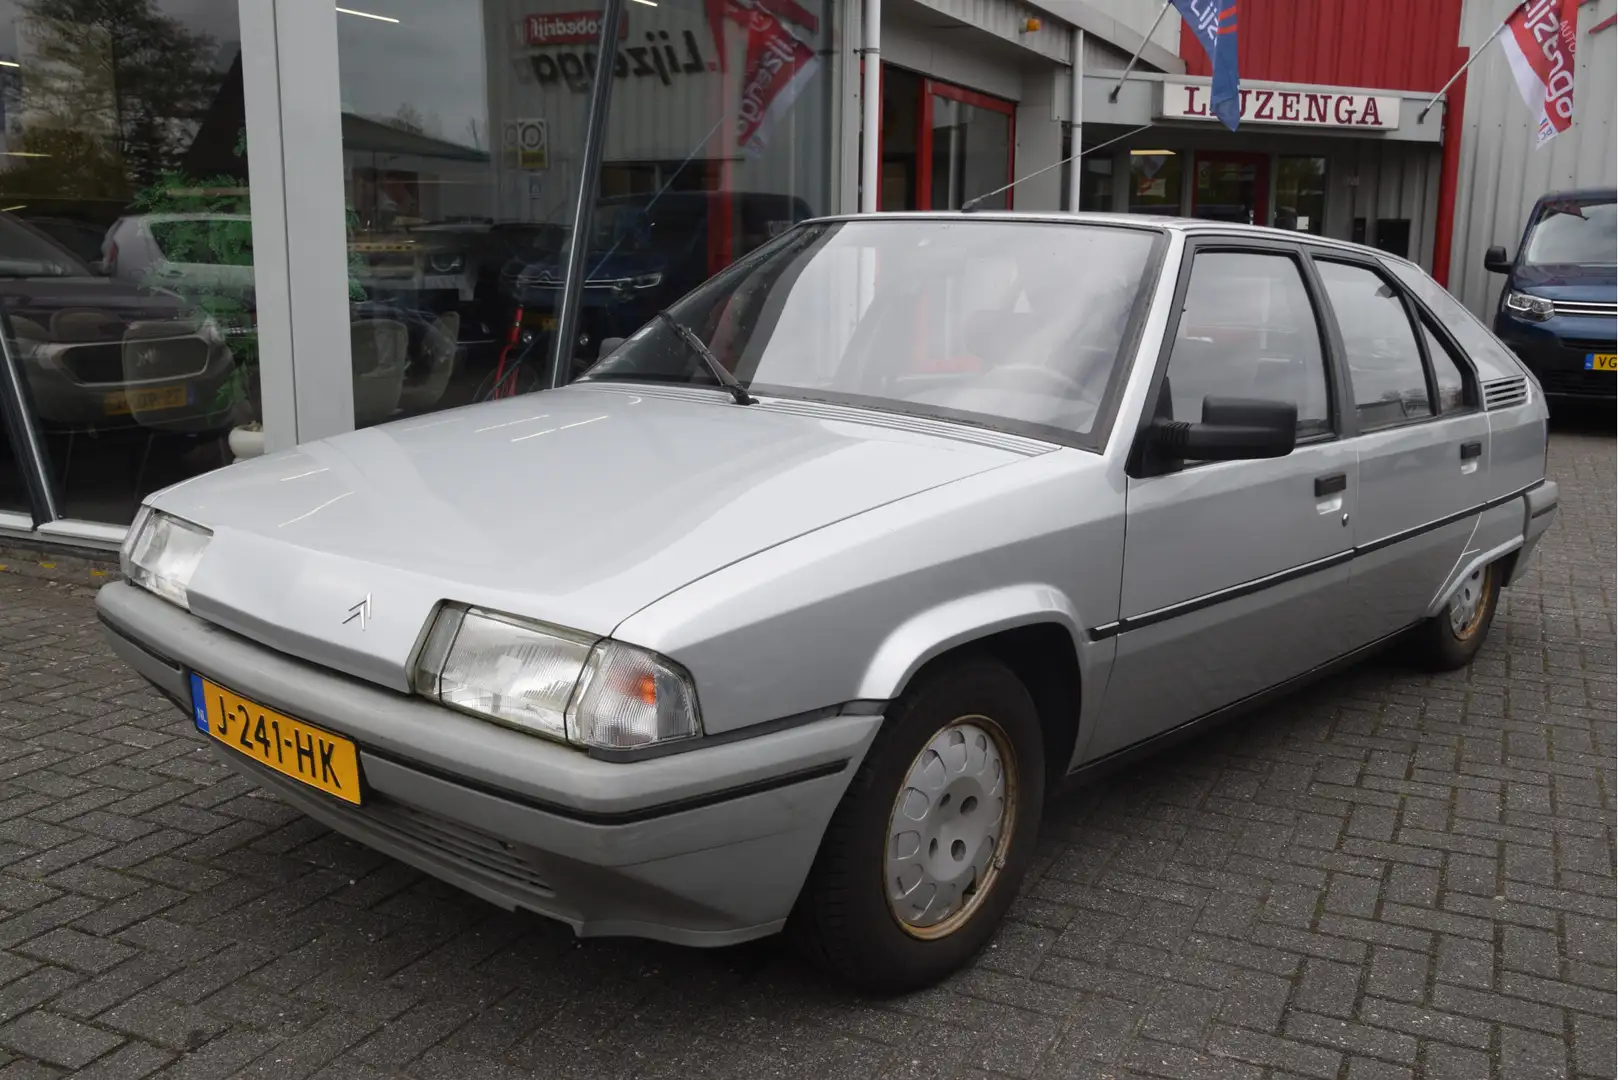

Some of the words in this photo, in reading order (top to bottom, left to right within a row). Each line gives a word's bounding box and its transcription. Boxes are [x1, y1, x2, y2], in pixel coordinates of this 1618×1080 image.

[1559, 20, 1576, 60] AUTO
[1183, 86, 1384, 125] LJZENGA
[217, 694, 342, 789] J-241-HK
